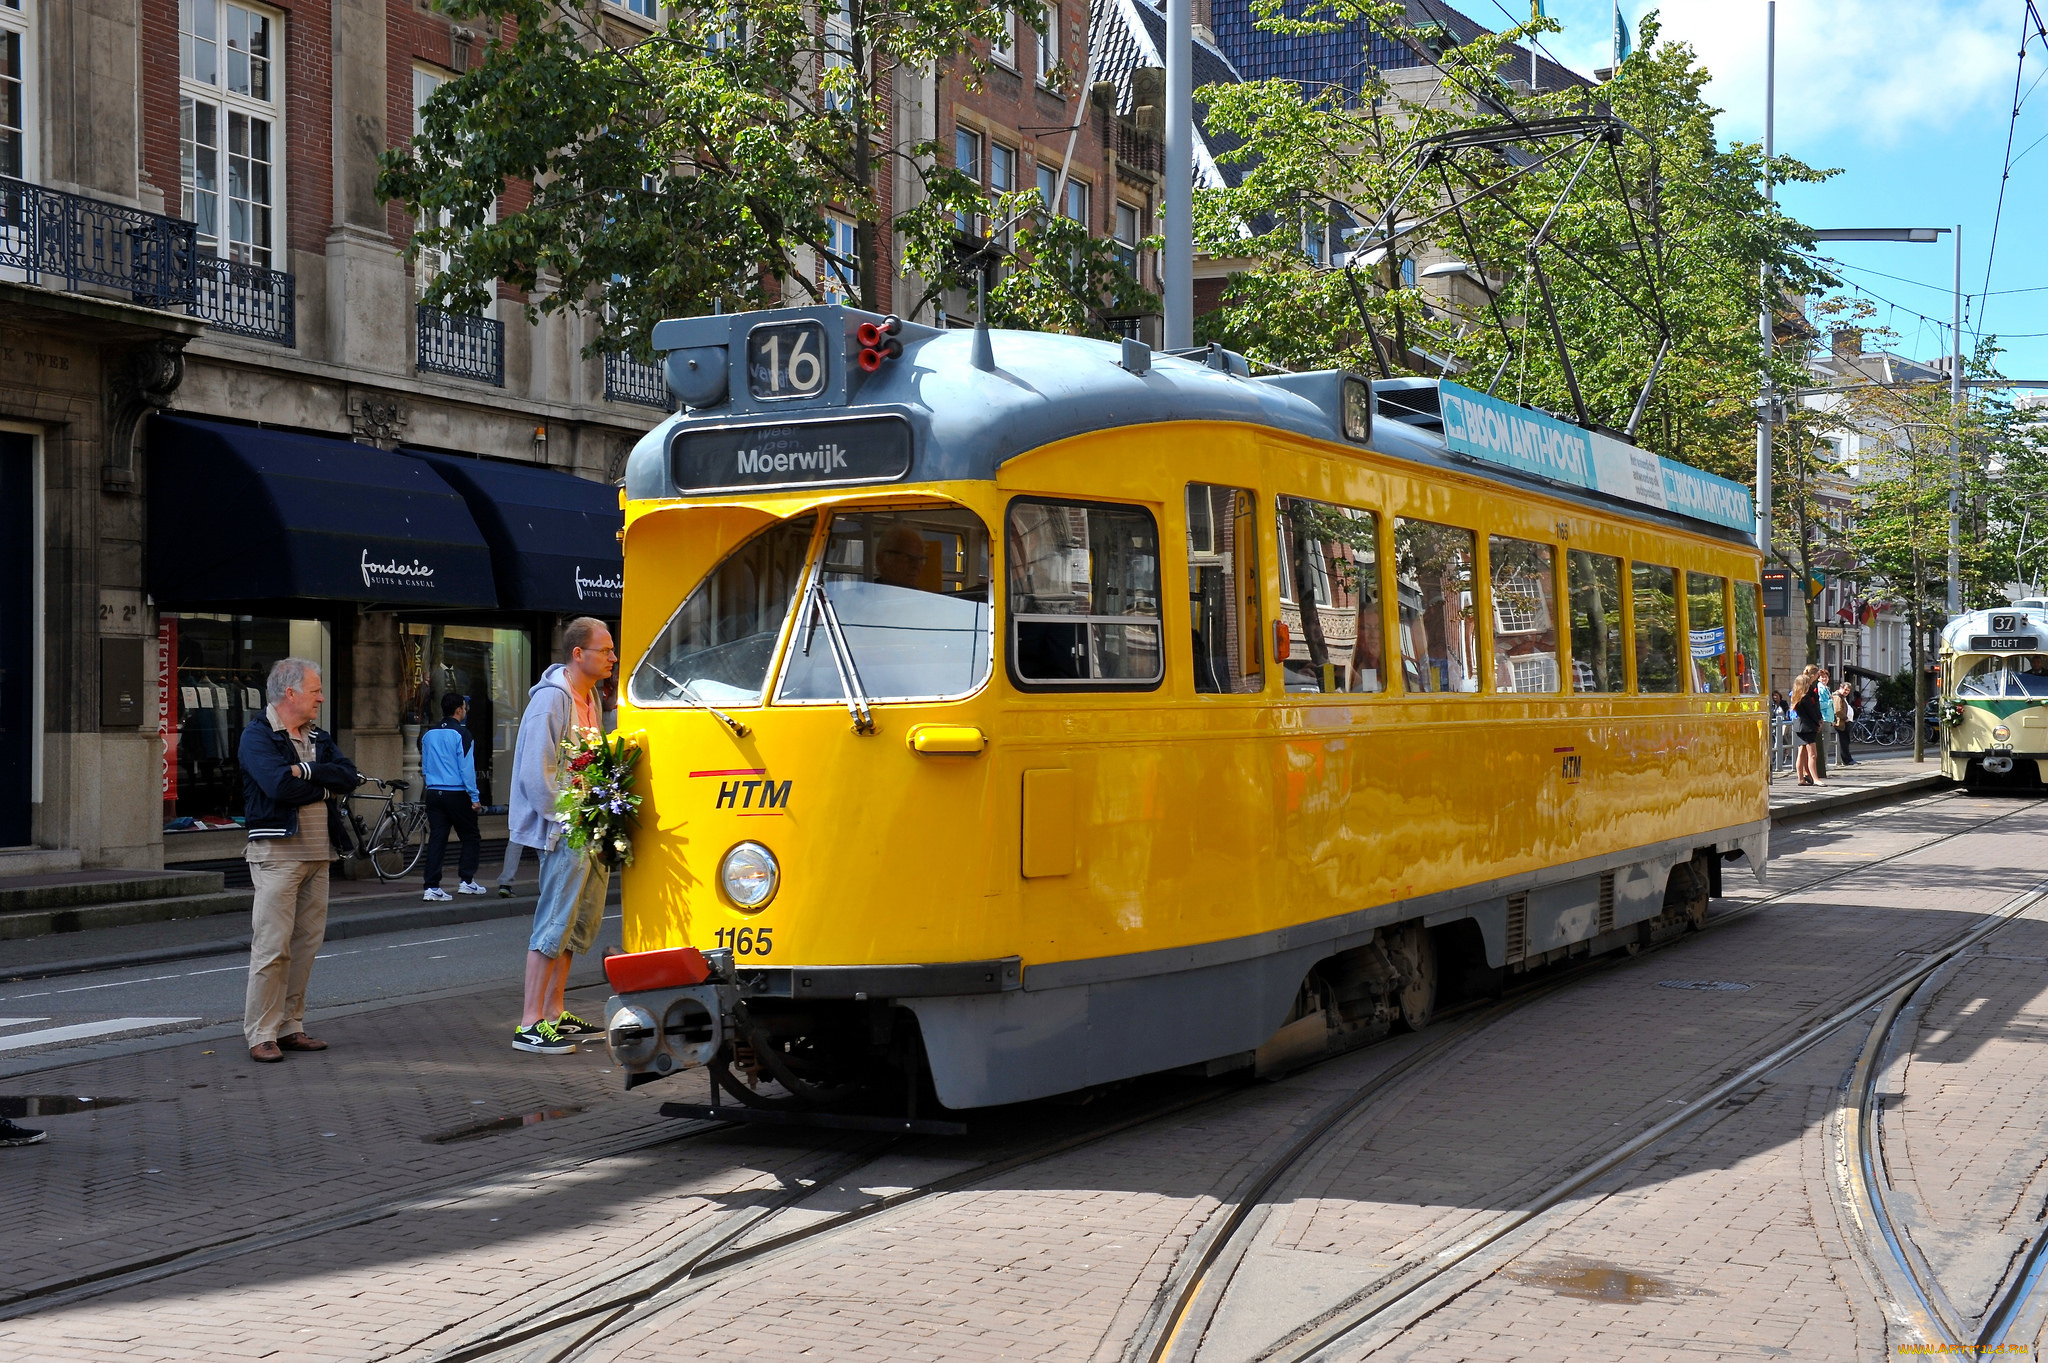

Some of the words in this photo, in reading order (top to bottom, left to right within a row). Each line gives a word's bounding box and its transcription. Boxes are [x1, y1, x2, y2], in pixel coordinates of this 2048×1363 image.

[24, 351, 69, 371] TWEE
[760, 331, 821, 392] 16
[1463, 399, 1513, 455] BISON
[1510, 415, 1588, 477] ANTI-VOCHT
[737, 443, 848, 474] Moerwijk
[1673, 471, 1706, 512] BISON
[361, 548, 434, 587] fonderie
[371, 576, 395, 585] SUITS
[405, 579, 435, 588] CASUAL
[575, 565, 625, 600] fonderi
[583, 590, 602, 598] SUITS
[1995, 617, 2014, 631] 37
[1991, 639, 2019, 648] DELFT
[1562, 756, 1581, 778] HTM
[715, 780, 793, 809] HTM
[714, 927, 773, 956] 1165
